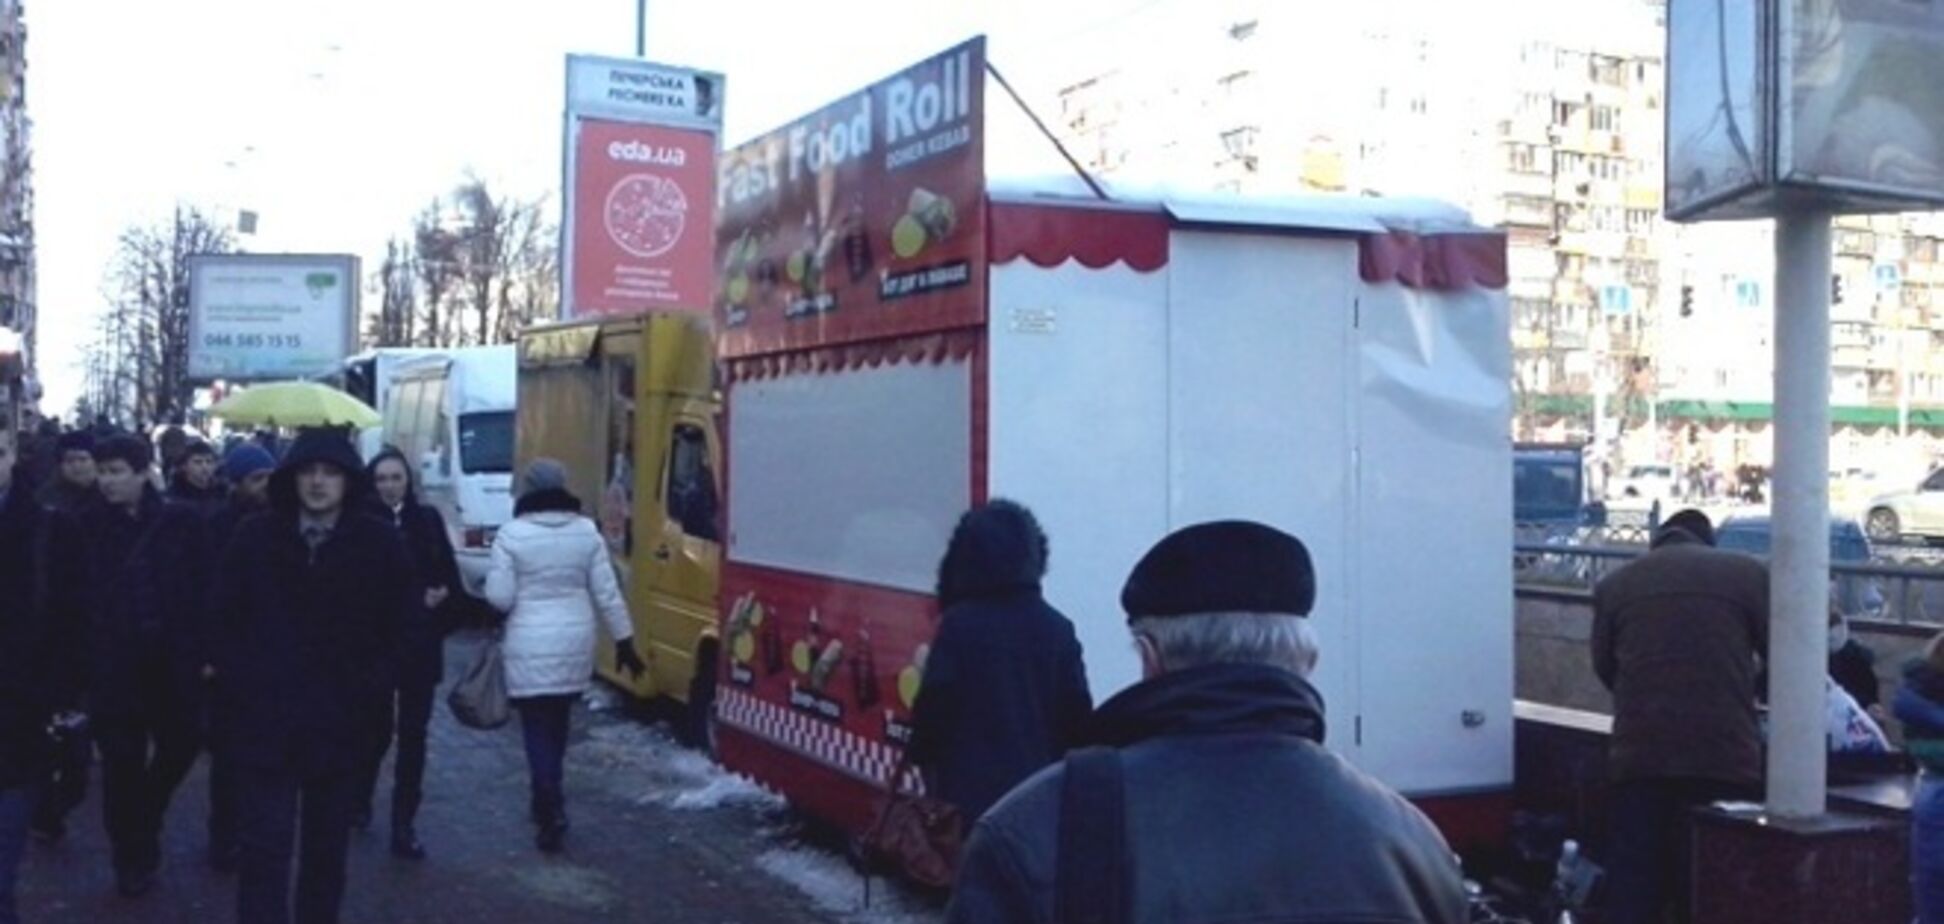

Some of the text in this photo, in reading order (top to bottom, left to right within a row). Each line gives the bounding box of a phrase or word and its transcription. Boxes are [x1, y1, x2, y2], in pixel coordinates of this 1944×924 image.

[607, 140, 686, 167] eda.ua
[717, 50, 971, 209] Fast Food Roll
